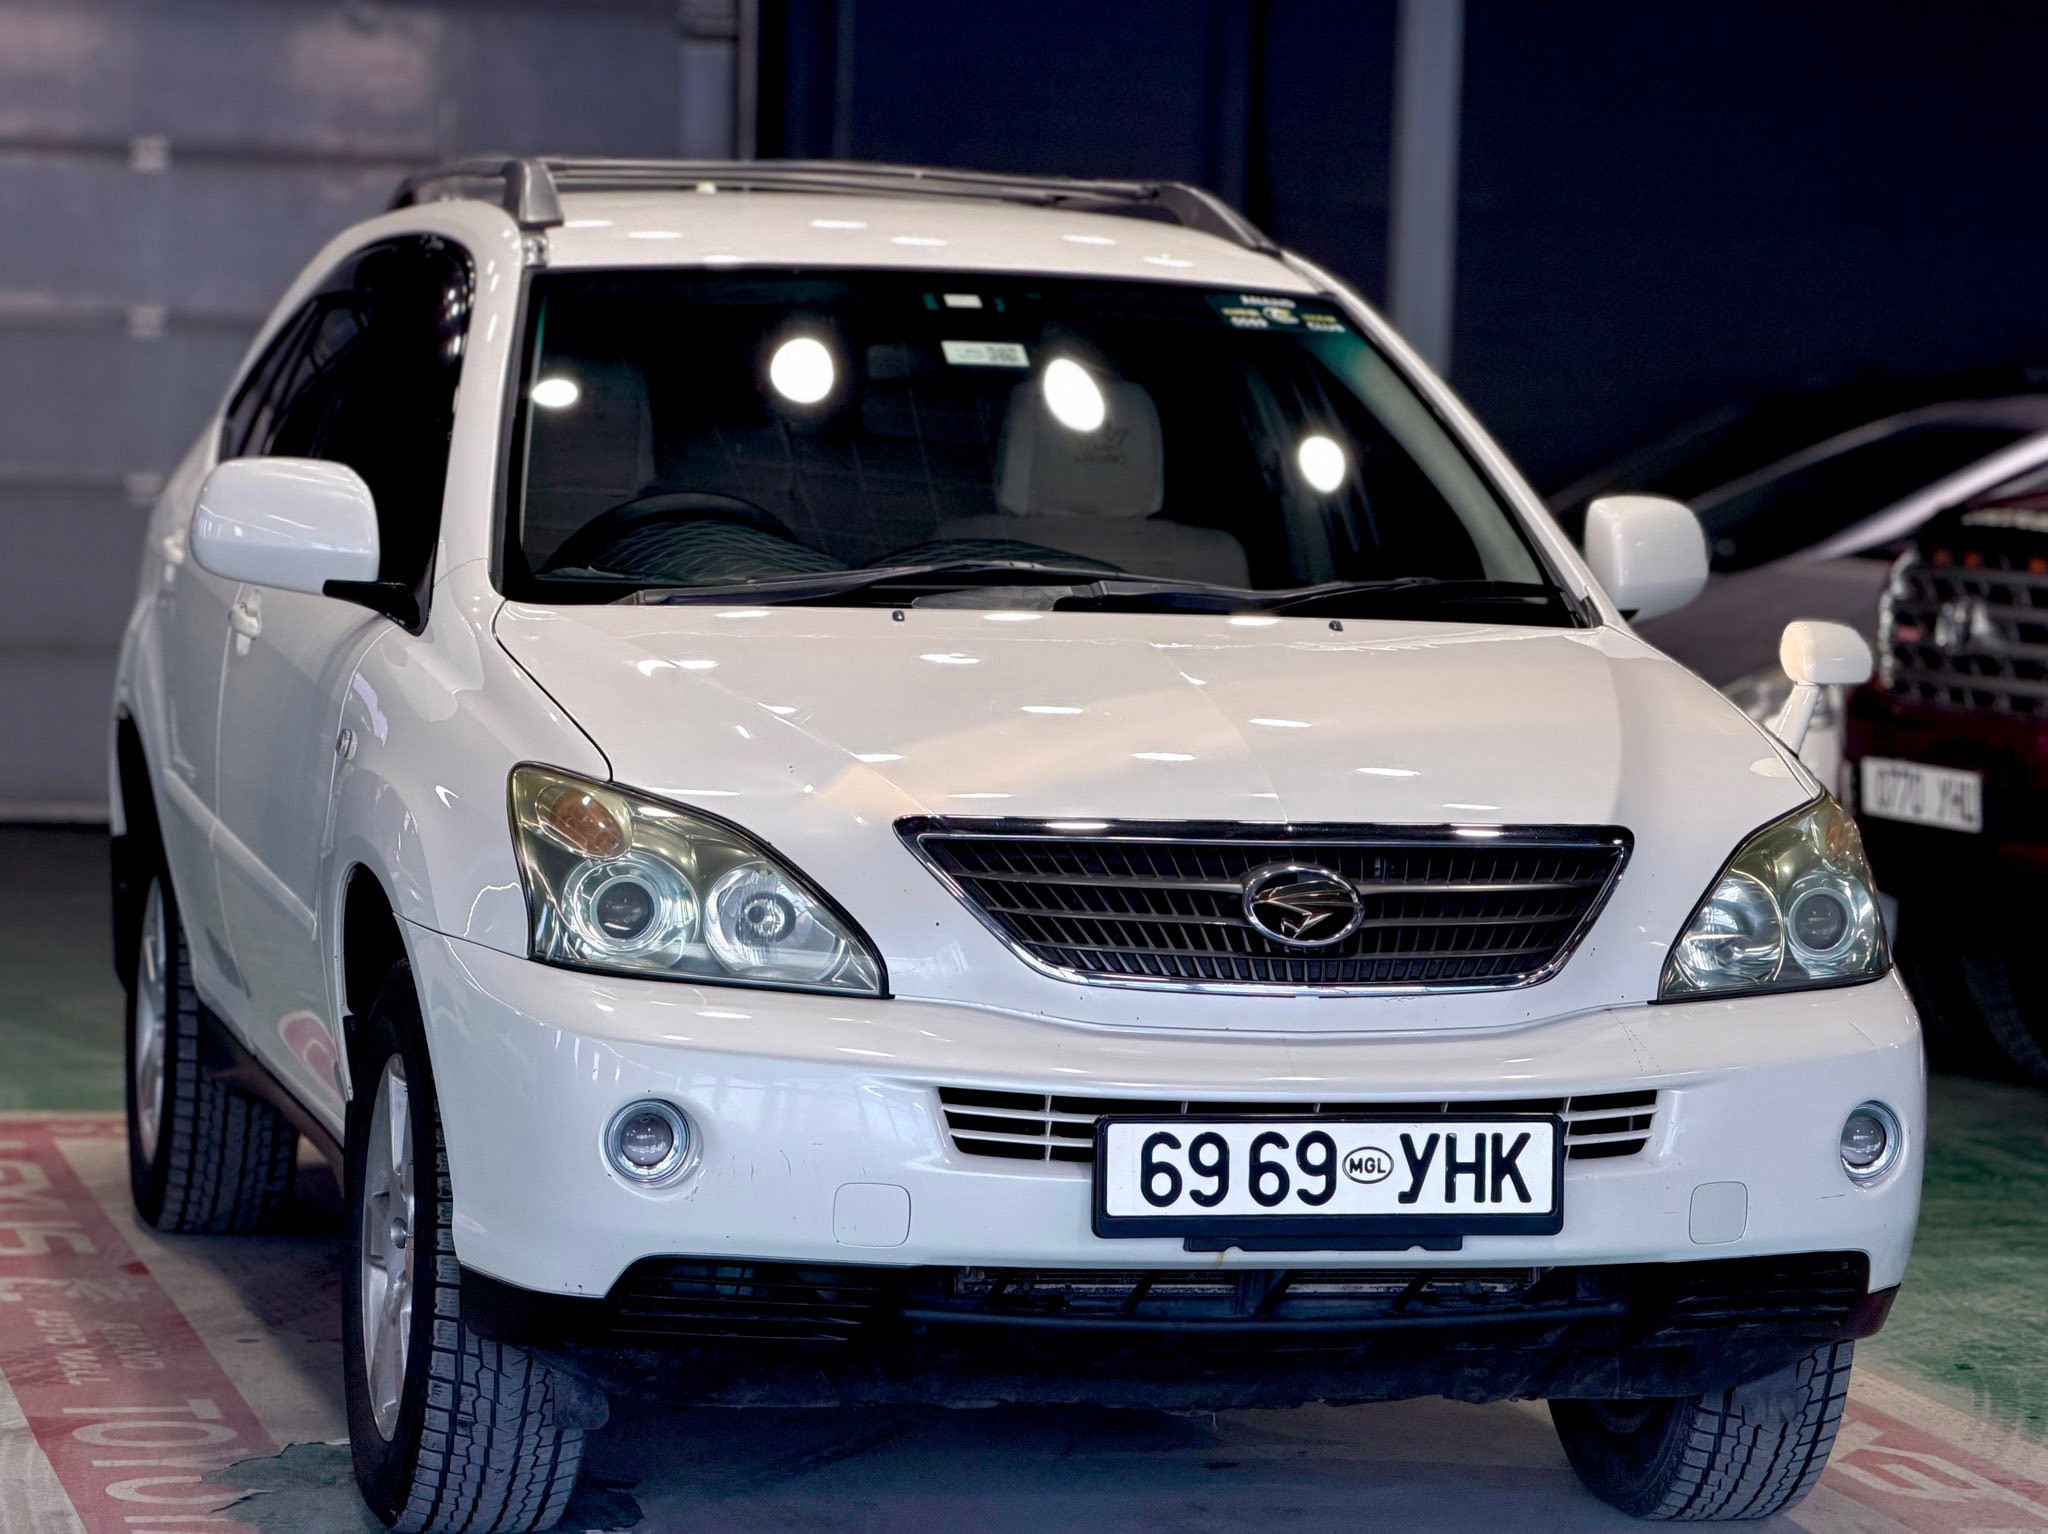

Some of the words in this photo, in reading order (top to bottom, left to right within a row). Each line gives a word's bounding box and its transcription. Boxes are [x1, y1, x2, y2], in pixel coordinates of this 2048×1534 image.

[1348, 1157, 1387, 1175] MGL
[1397, 1132, 1533, 1204] УНК
[63, 1398, 273, 1534] TOYO
